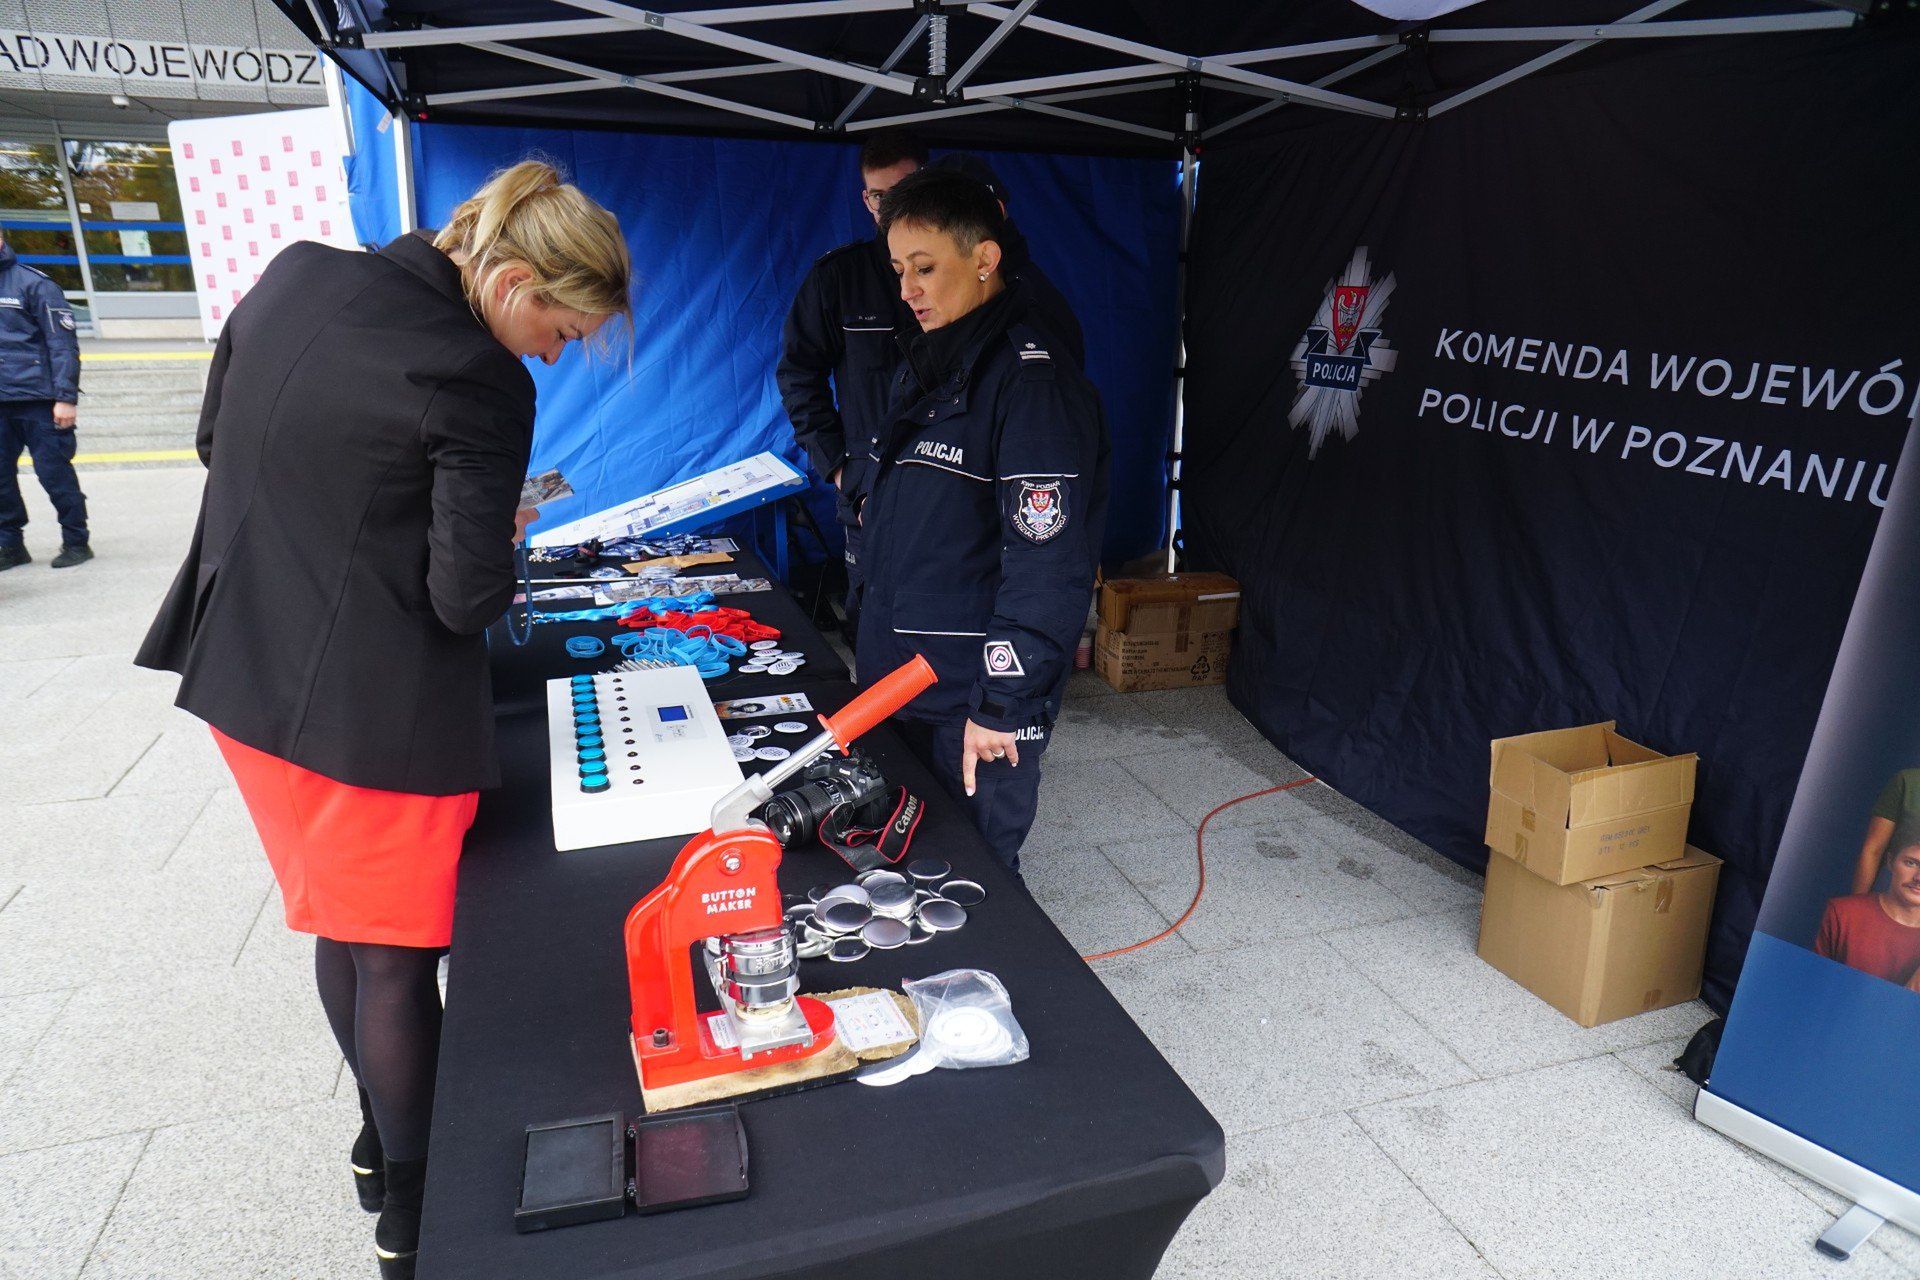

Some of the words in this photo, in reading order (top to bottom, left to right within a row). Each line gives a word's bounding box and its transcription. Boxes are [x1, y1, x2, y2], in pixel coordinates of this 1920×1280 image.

[1312, 362, 1356, 383] POLICJA
[1434, 328, 1629, 386] KOMENDA
[1650, 353, 1919, 421] WOJEWÓ
[1418, 388, 1559, 445] POLICJI
[1572, 414, 1615, 454] W
[914, 440, 963, 465] POLICJA
[894, 794, 918, 834] Canon
[701, 886, 757, 904] BUTTON
[706, 898, 753, 915] MAKER
